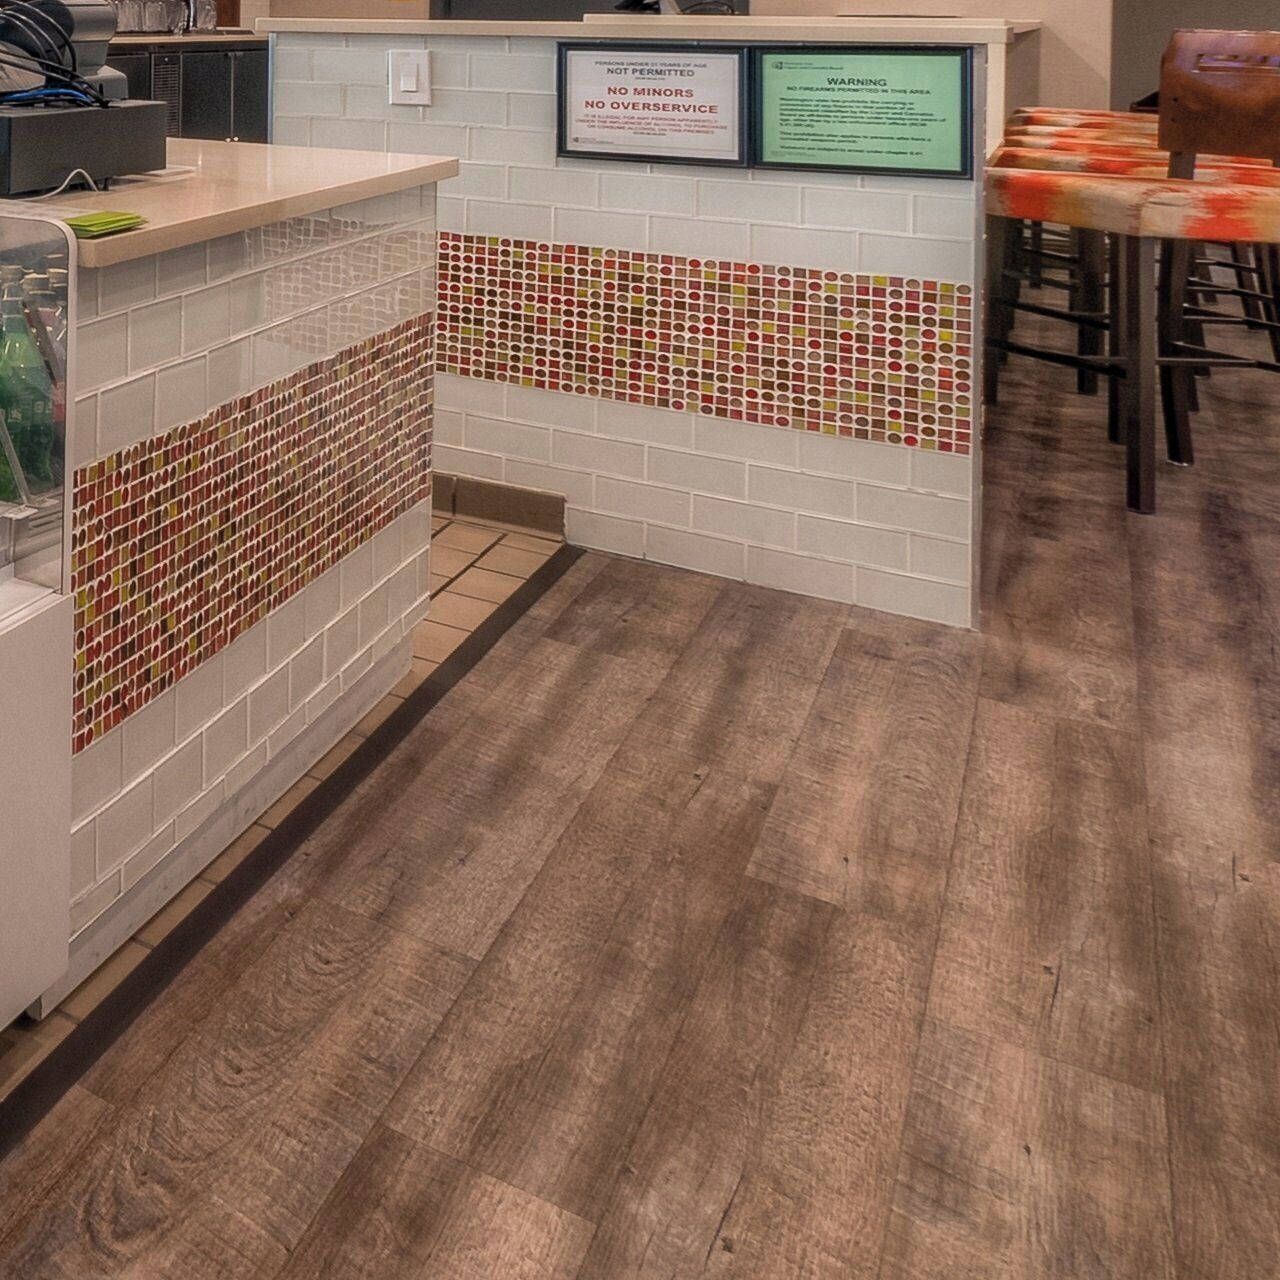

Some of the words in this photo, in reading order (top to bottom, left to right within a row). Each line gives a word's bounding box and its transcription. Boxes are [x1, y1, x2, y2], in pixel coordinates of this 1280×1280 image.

[607, 67, 628, 75] NOT
[631, 68, 696, 77] PERMITTED
[827, 77, 887, 87] WARNING
[608, 87, 629, 96] NO
[633, 87, 694, 98] MINORS
[585, 100, 605, 110] NO
[610, 101, 719, 114] OVERSERVICE
